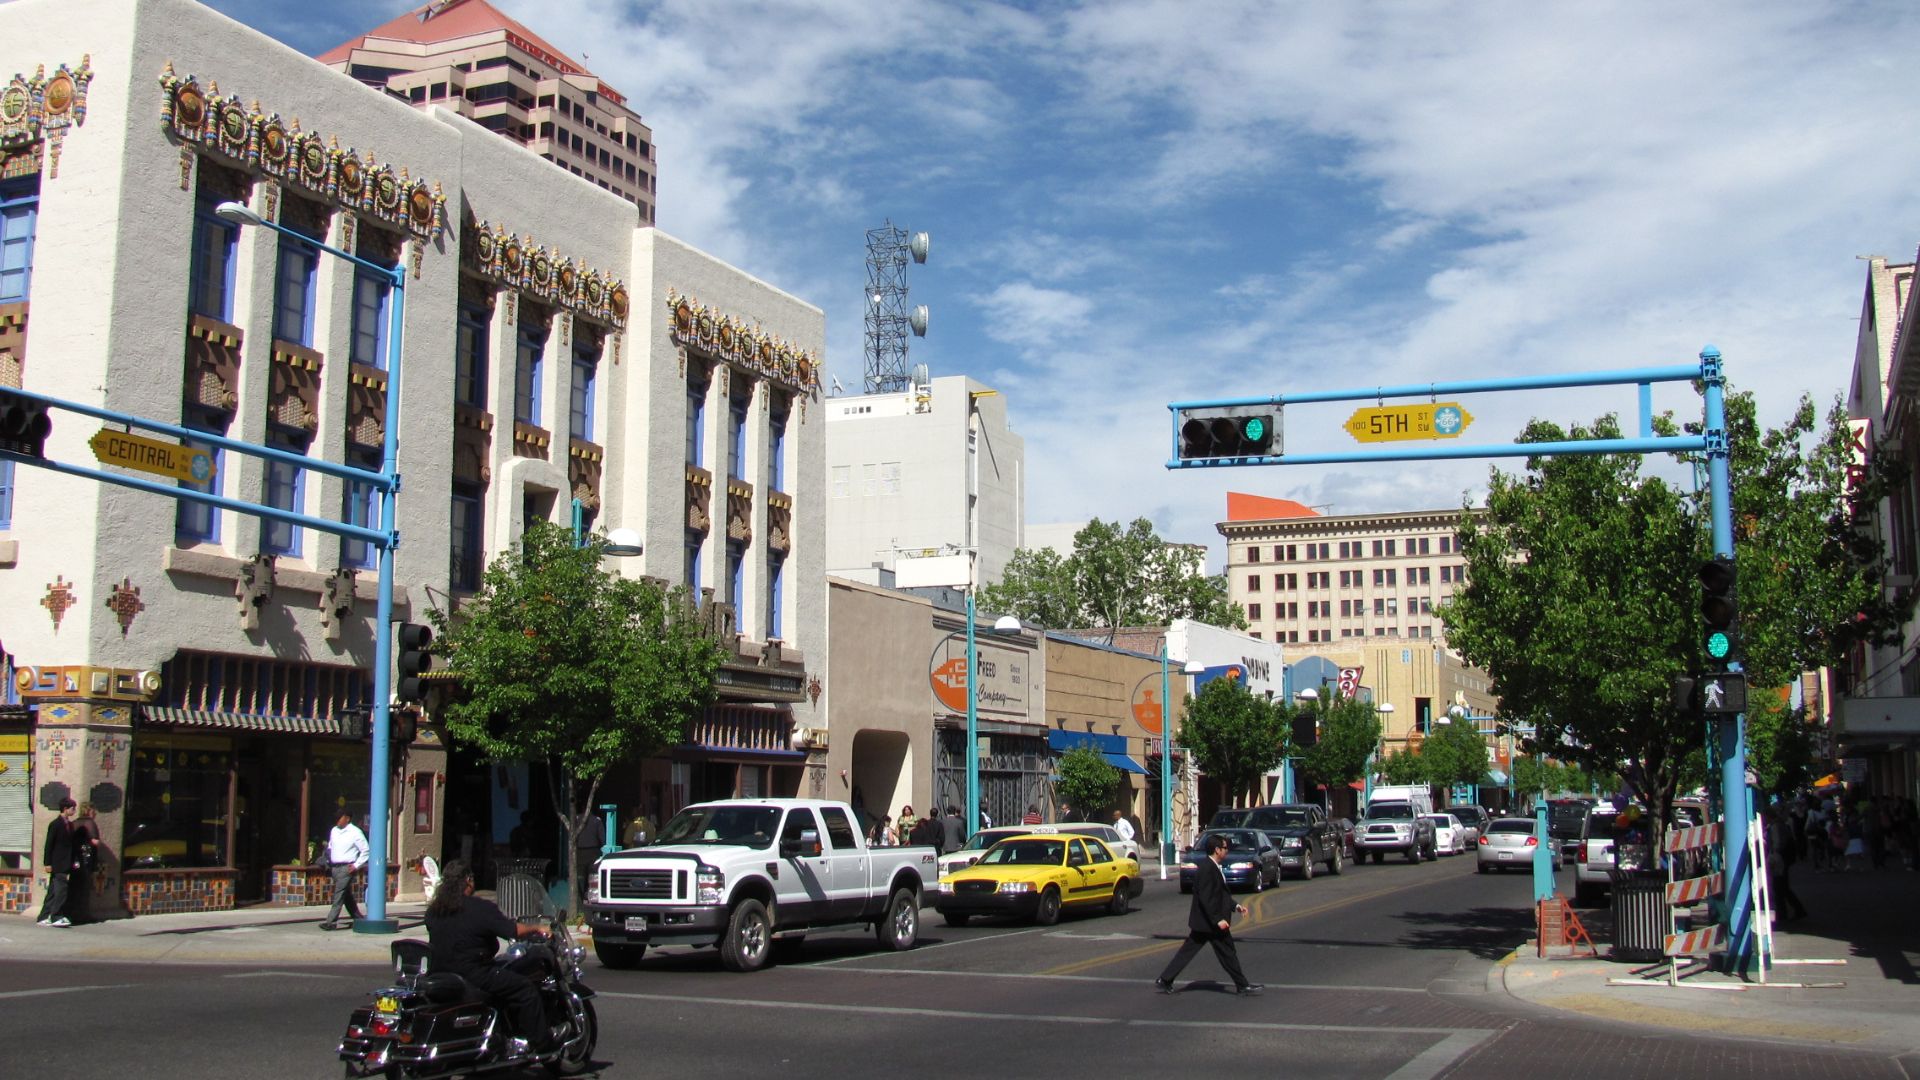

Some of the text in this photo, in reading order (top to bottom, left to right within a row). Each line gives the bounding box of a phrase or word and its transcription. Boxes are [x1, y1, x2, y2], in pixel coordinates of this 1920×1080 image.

[1353, 413, 1408, 434] 100 5TH
[1417, 412, 1428, 420] ST
[1417, 423, 1429, 432] SW
[109, 438, 175, 469] CENTRAL
